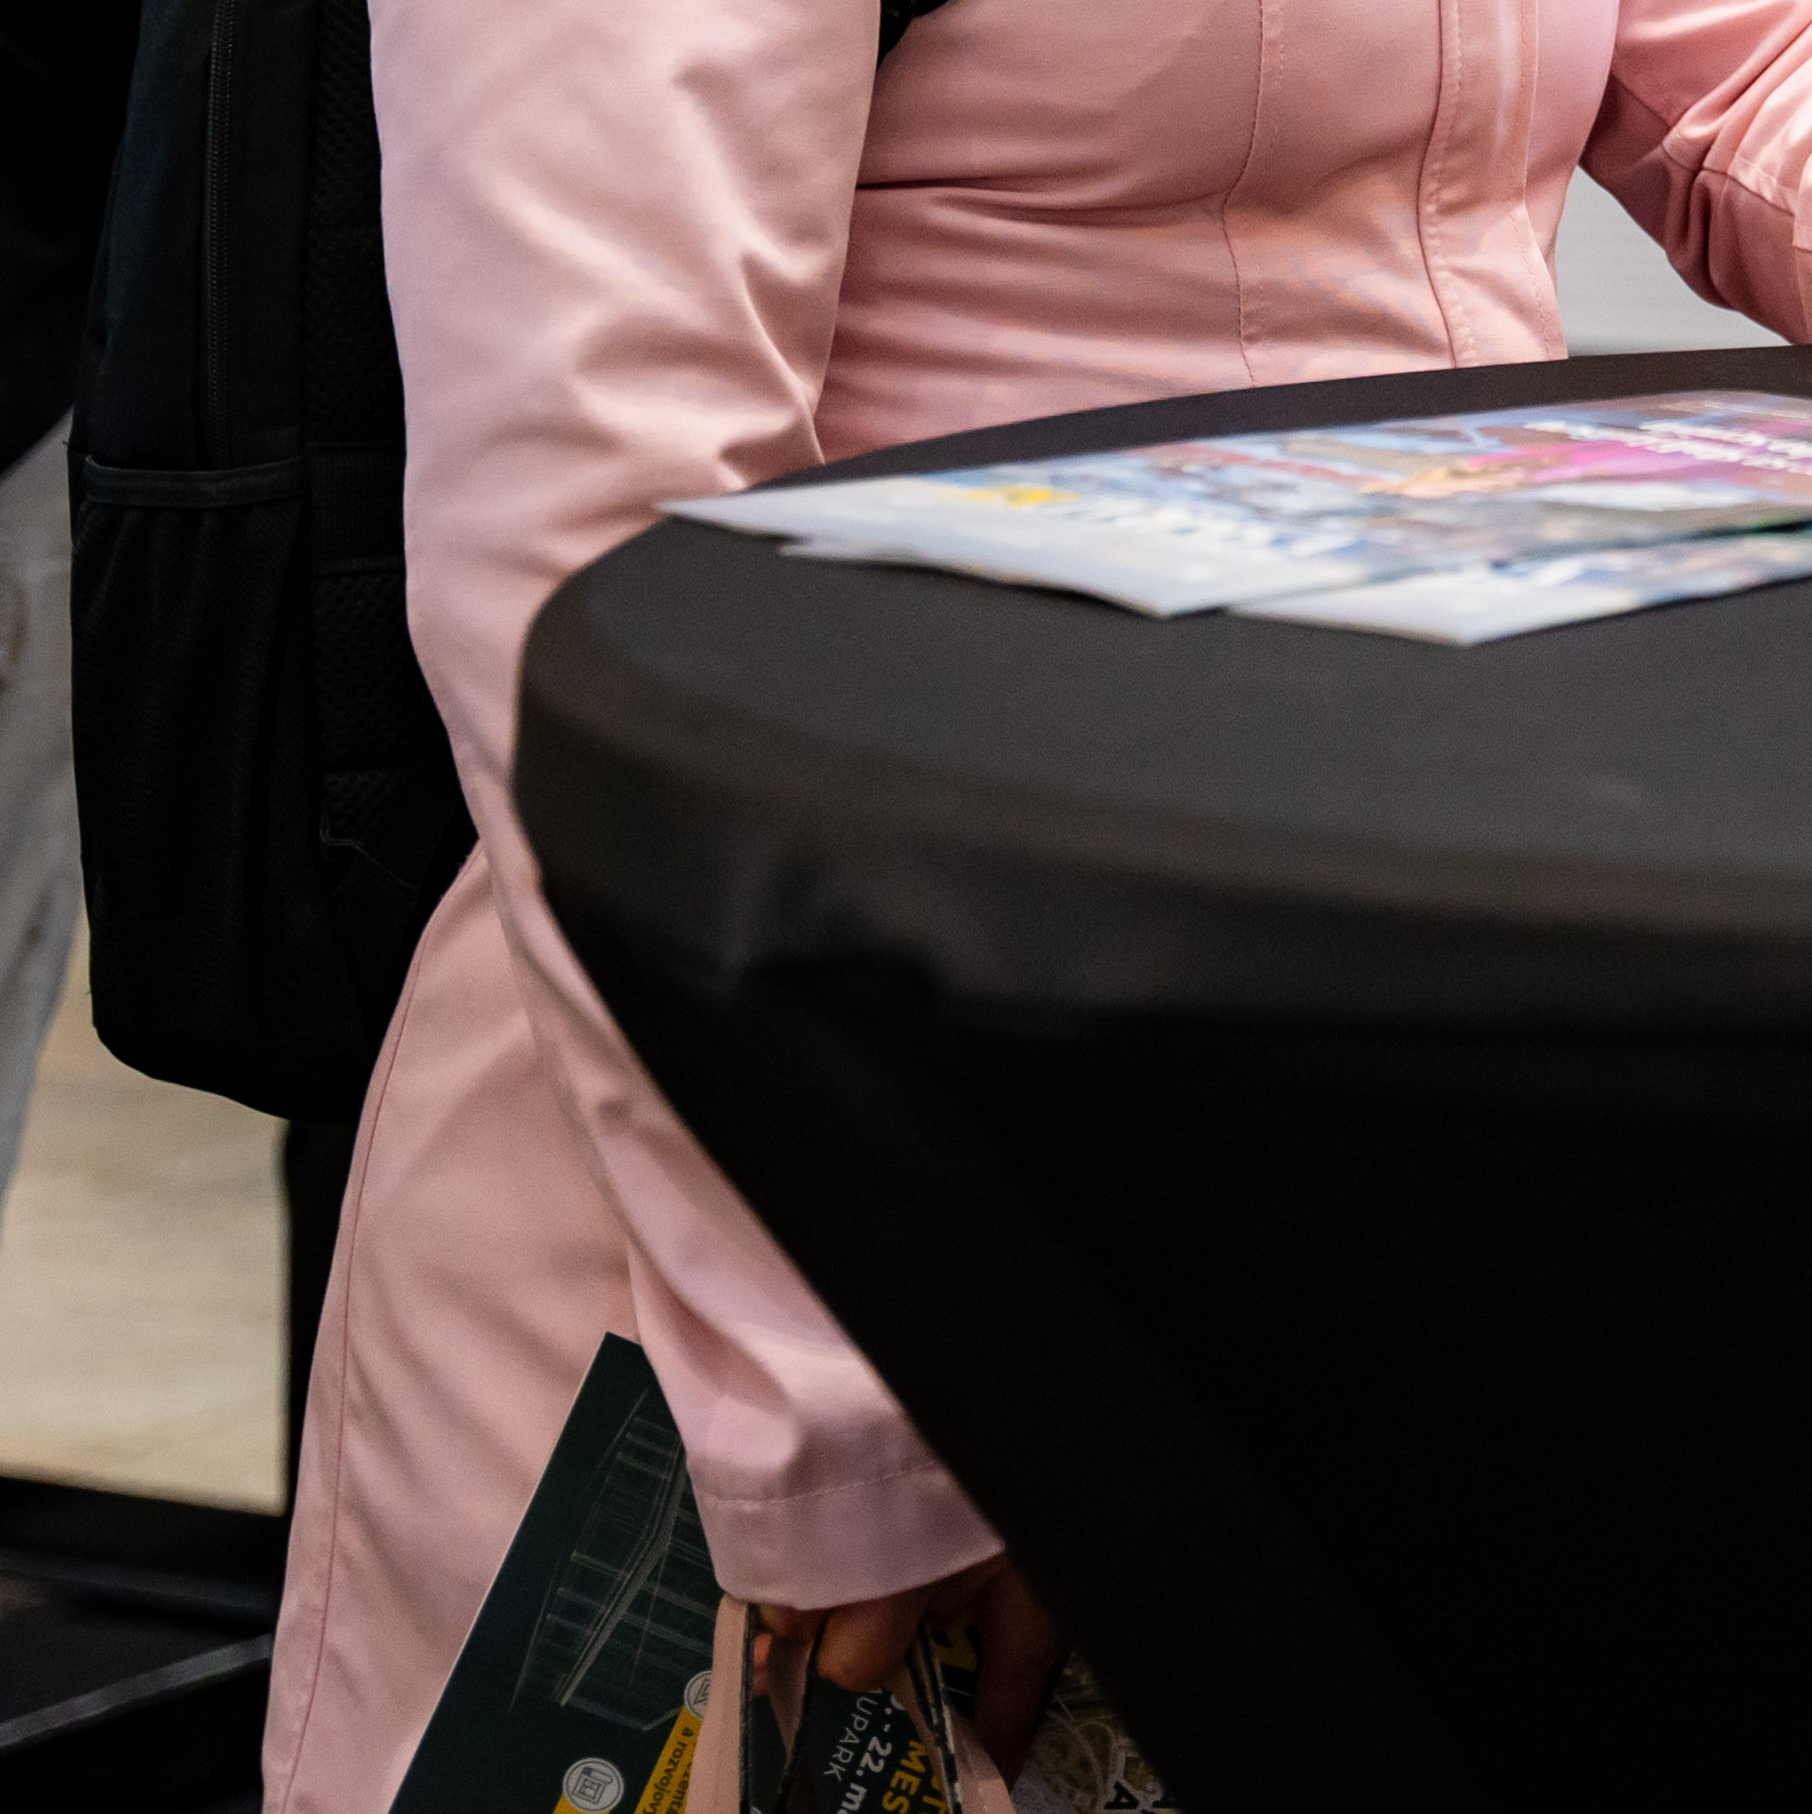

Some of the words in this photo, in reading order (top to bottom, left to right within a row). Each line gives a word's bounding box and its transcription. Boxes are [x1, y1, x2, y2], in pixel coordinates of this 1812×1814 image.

[823, 1688, 883, 1783] UPARK
[855, 1735, 893, 1778] 22.
[643, 1741, 688, 1814] rozvojov
